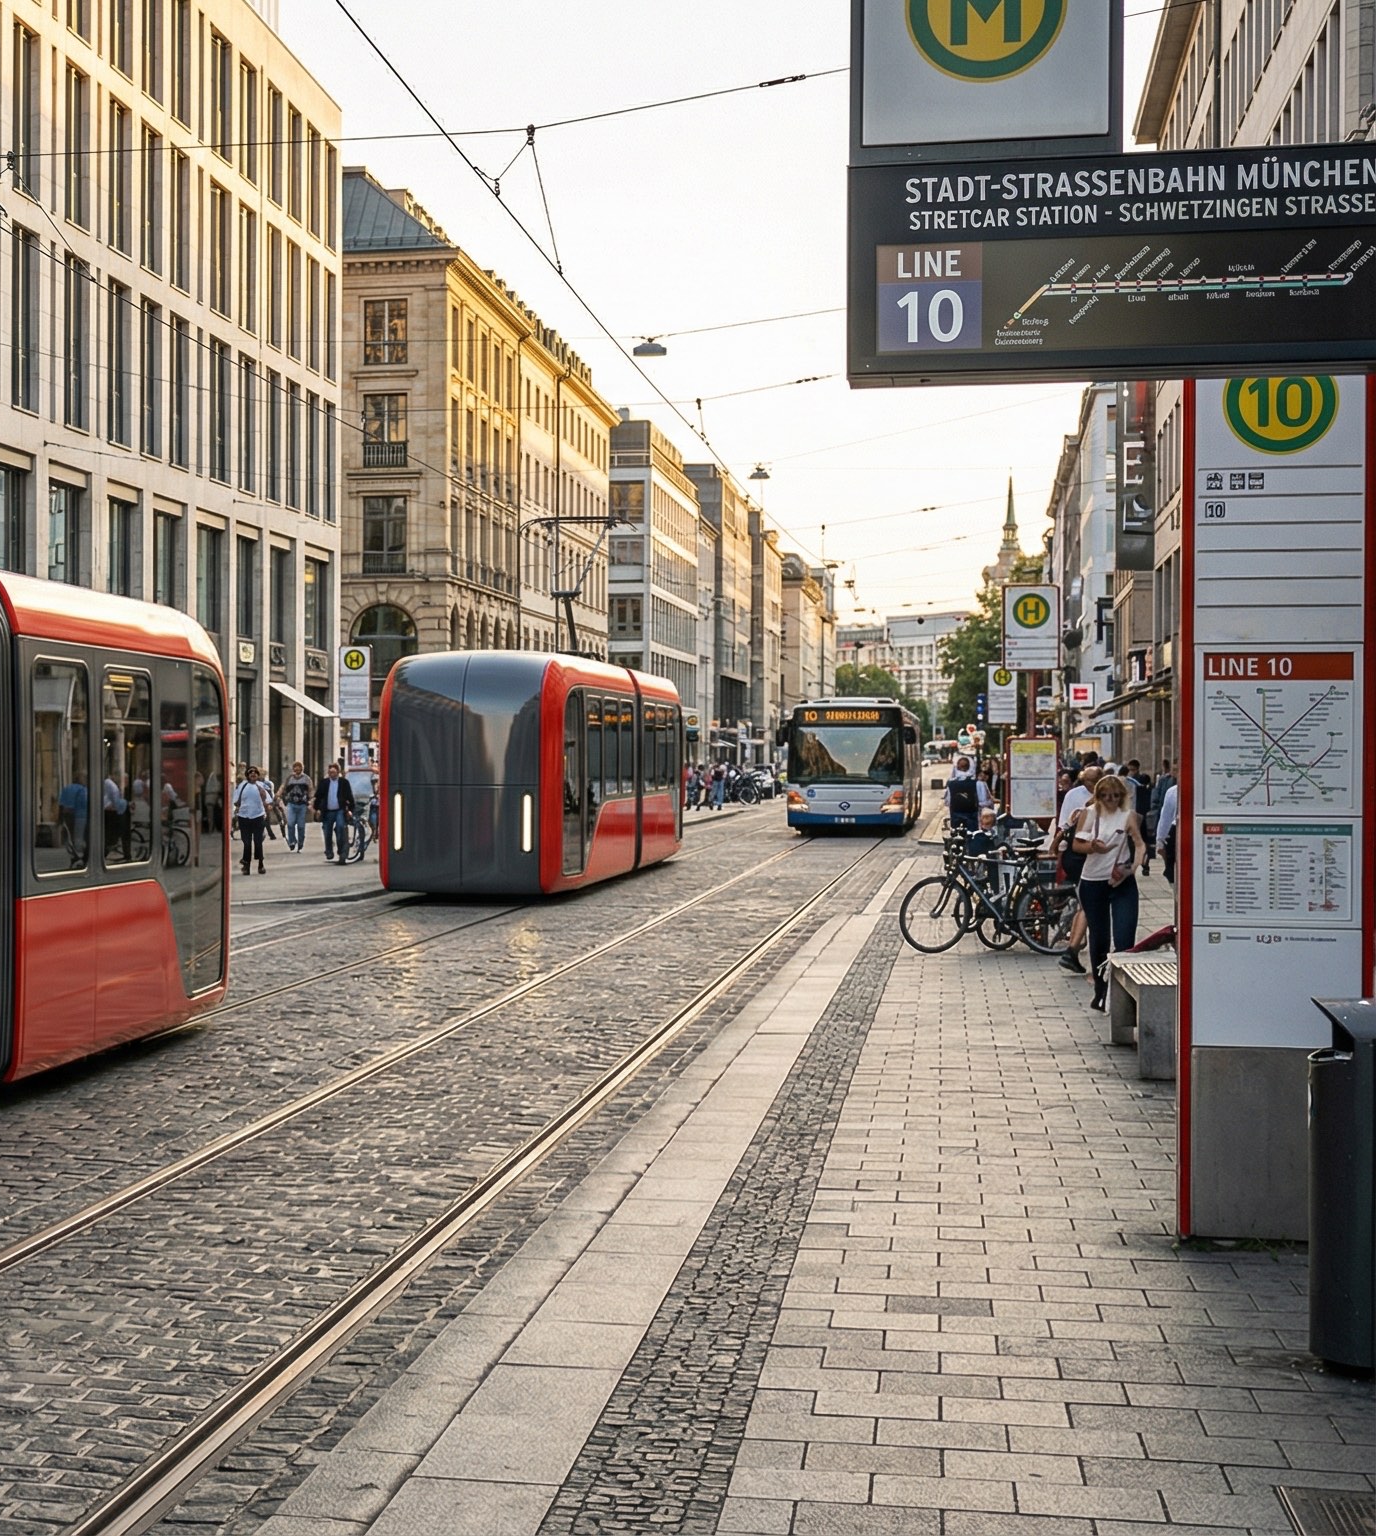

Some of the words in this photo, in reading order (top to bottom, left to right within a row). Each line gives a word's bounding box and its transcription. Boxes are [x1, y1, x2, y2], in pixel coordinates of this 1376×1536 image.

[905, 165, 1225, 204] STADT-STRASSENBAHN
[1237, 156, 1376, 190] MÜNCHEN
[909, 208, 1010, 231] STRETCAR
[1016, 204, 1098, 227] STATION
[1119, 197, 1278, 223] SCHWETZINGEN
[1285, 193, 1376, 216] STRASSE
[897, 249, 962, 279] LINE
[896, 289, 964, 344] 10
[1248, 377, 1313, 428] 10
[1207, 504, 1223, 518] 10
[1023, 601, 1040, 621] H
[1208, 657, 1259, 676] LINE
[1267, 657, 1293, 676] 10
